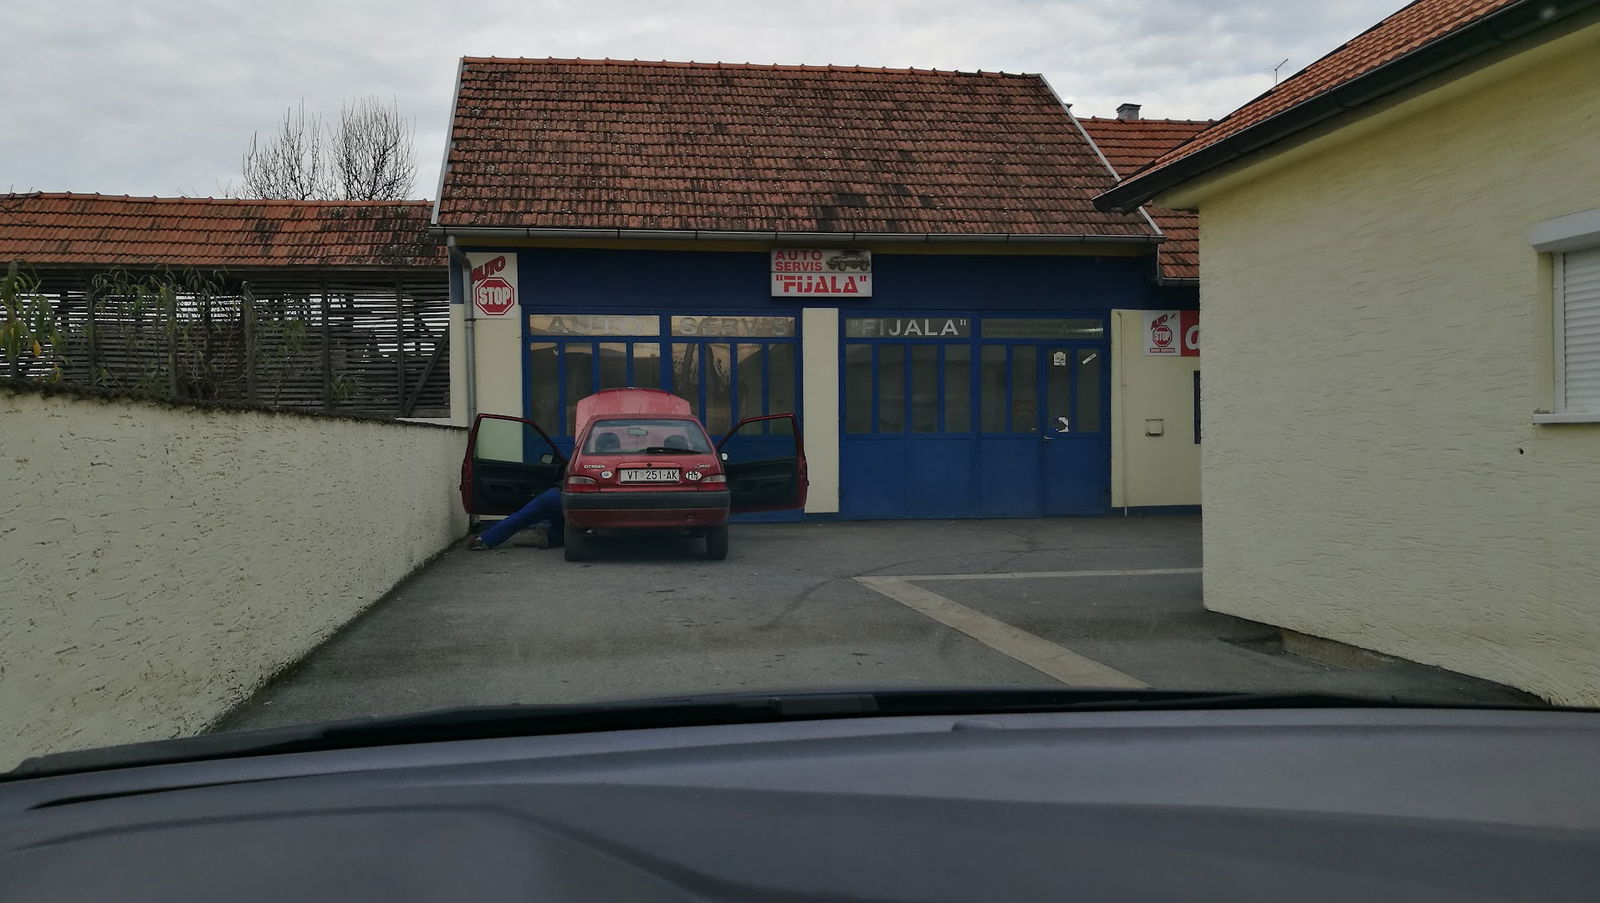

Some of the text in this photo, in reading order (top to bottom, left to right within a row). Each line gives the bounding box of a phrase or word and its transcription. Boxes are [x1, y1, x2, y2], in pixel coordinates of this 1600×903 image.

[775, 249, 823, 261] AUTO
[471, 255, 506, 283] AUTO
[775, 261, 823, 272] SERVIS
[775, 275, 867, 293] "FIJALA"
[479, 287, 511, 305] STOP
[548, 316, 645, 334] AUTO
[1153, 331, 1171, 341] STOP
[627, 470, 639, 480] VT
